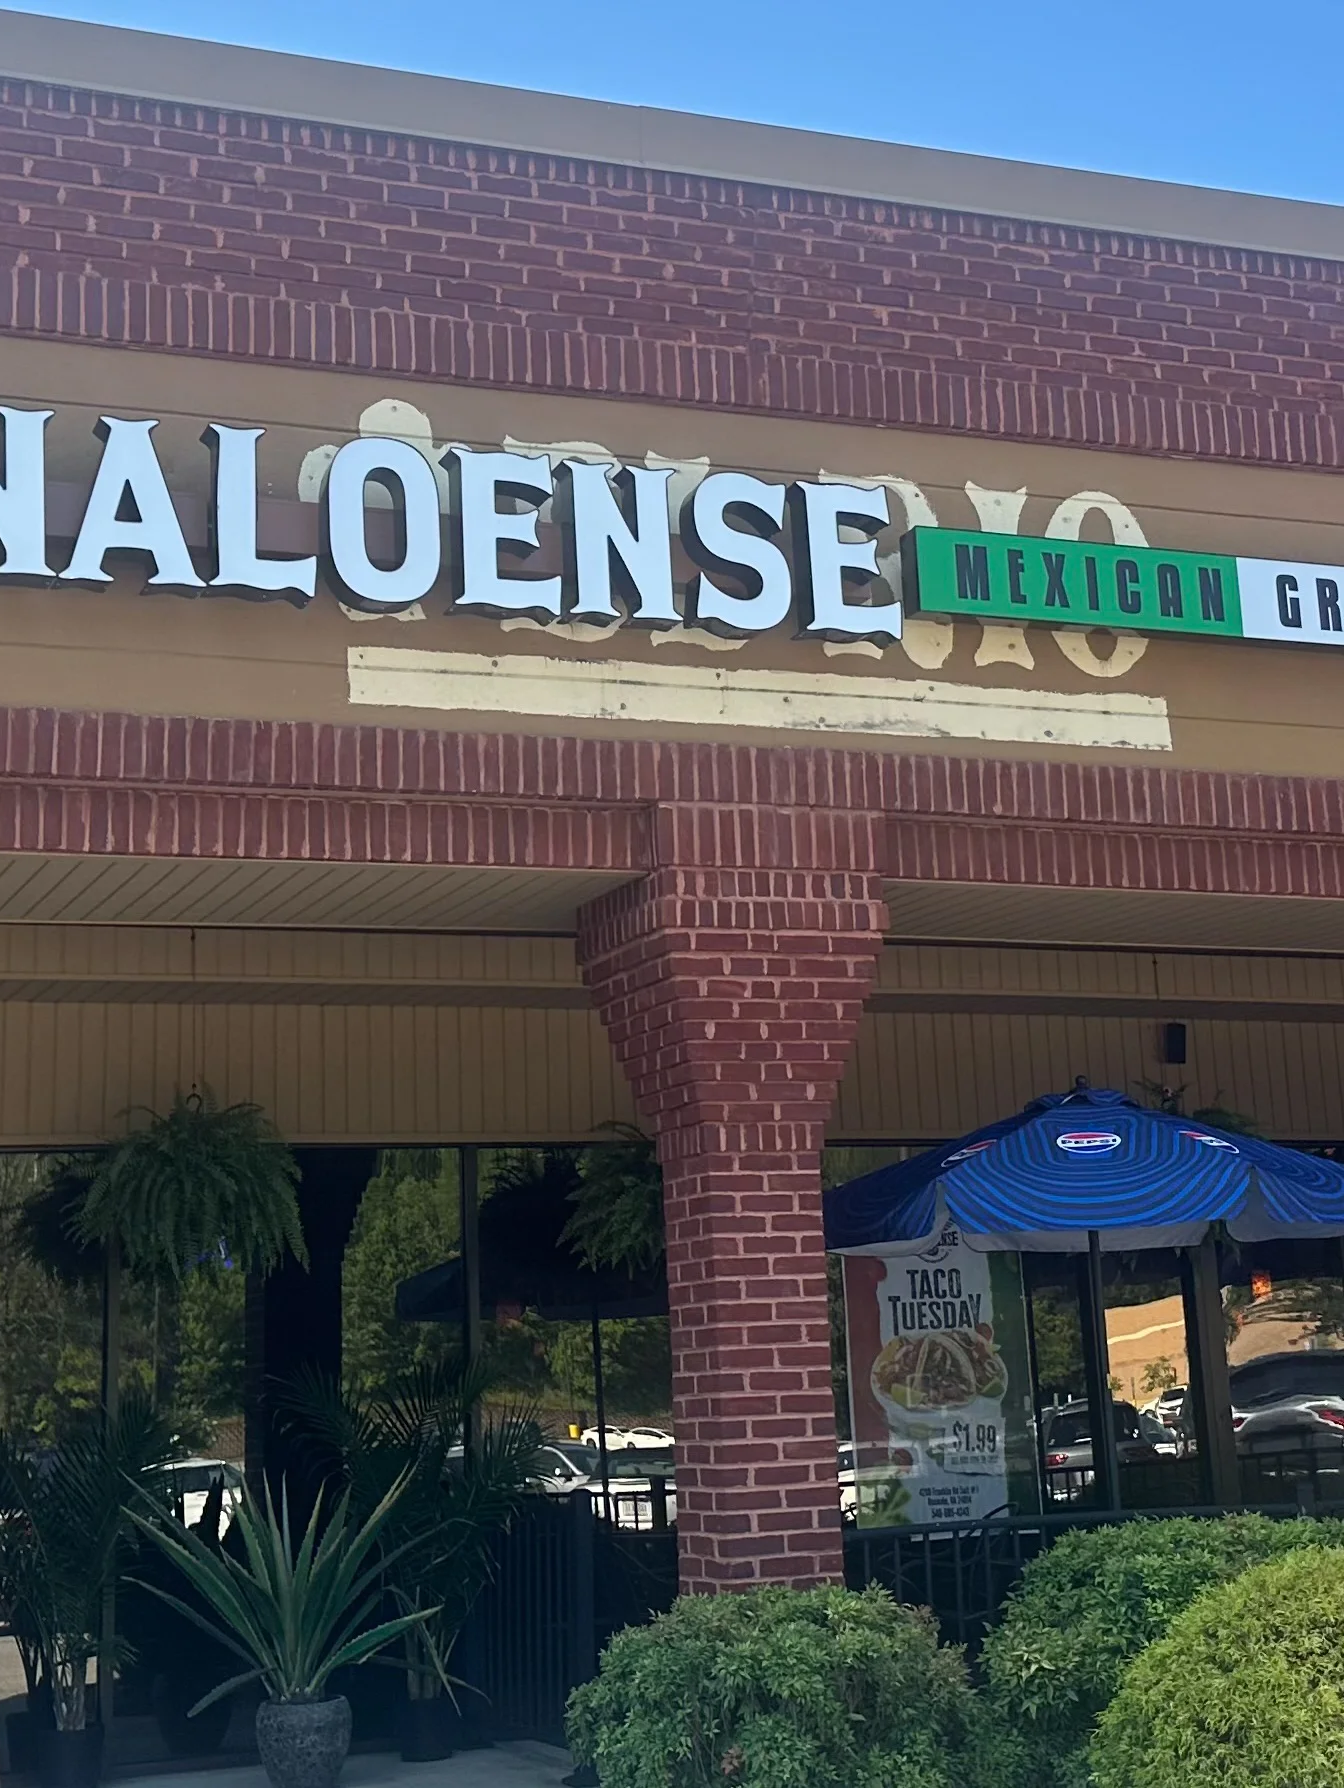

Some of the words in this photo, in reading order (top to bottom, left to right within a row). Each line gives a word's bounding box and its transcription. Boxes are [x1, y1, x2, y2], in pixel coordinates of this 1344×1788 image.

[954, 543, 1226, 623] MEXICAN
[906, 1268, 962, 1300] TACO
[887, 1293, 983, 1336] TUESDAY
[953, 1420, 996, 1453] $1.99
